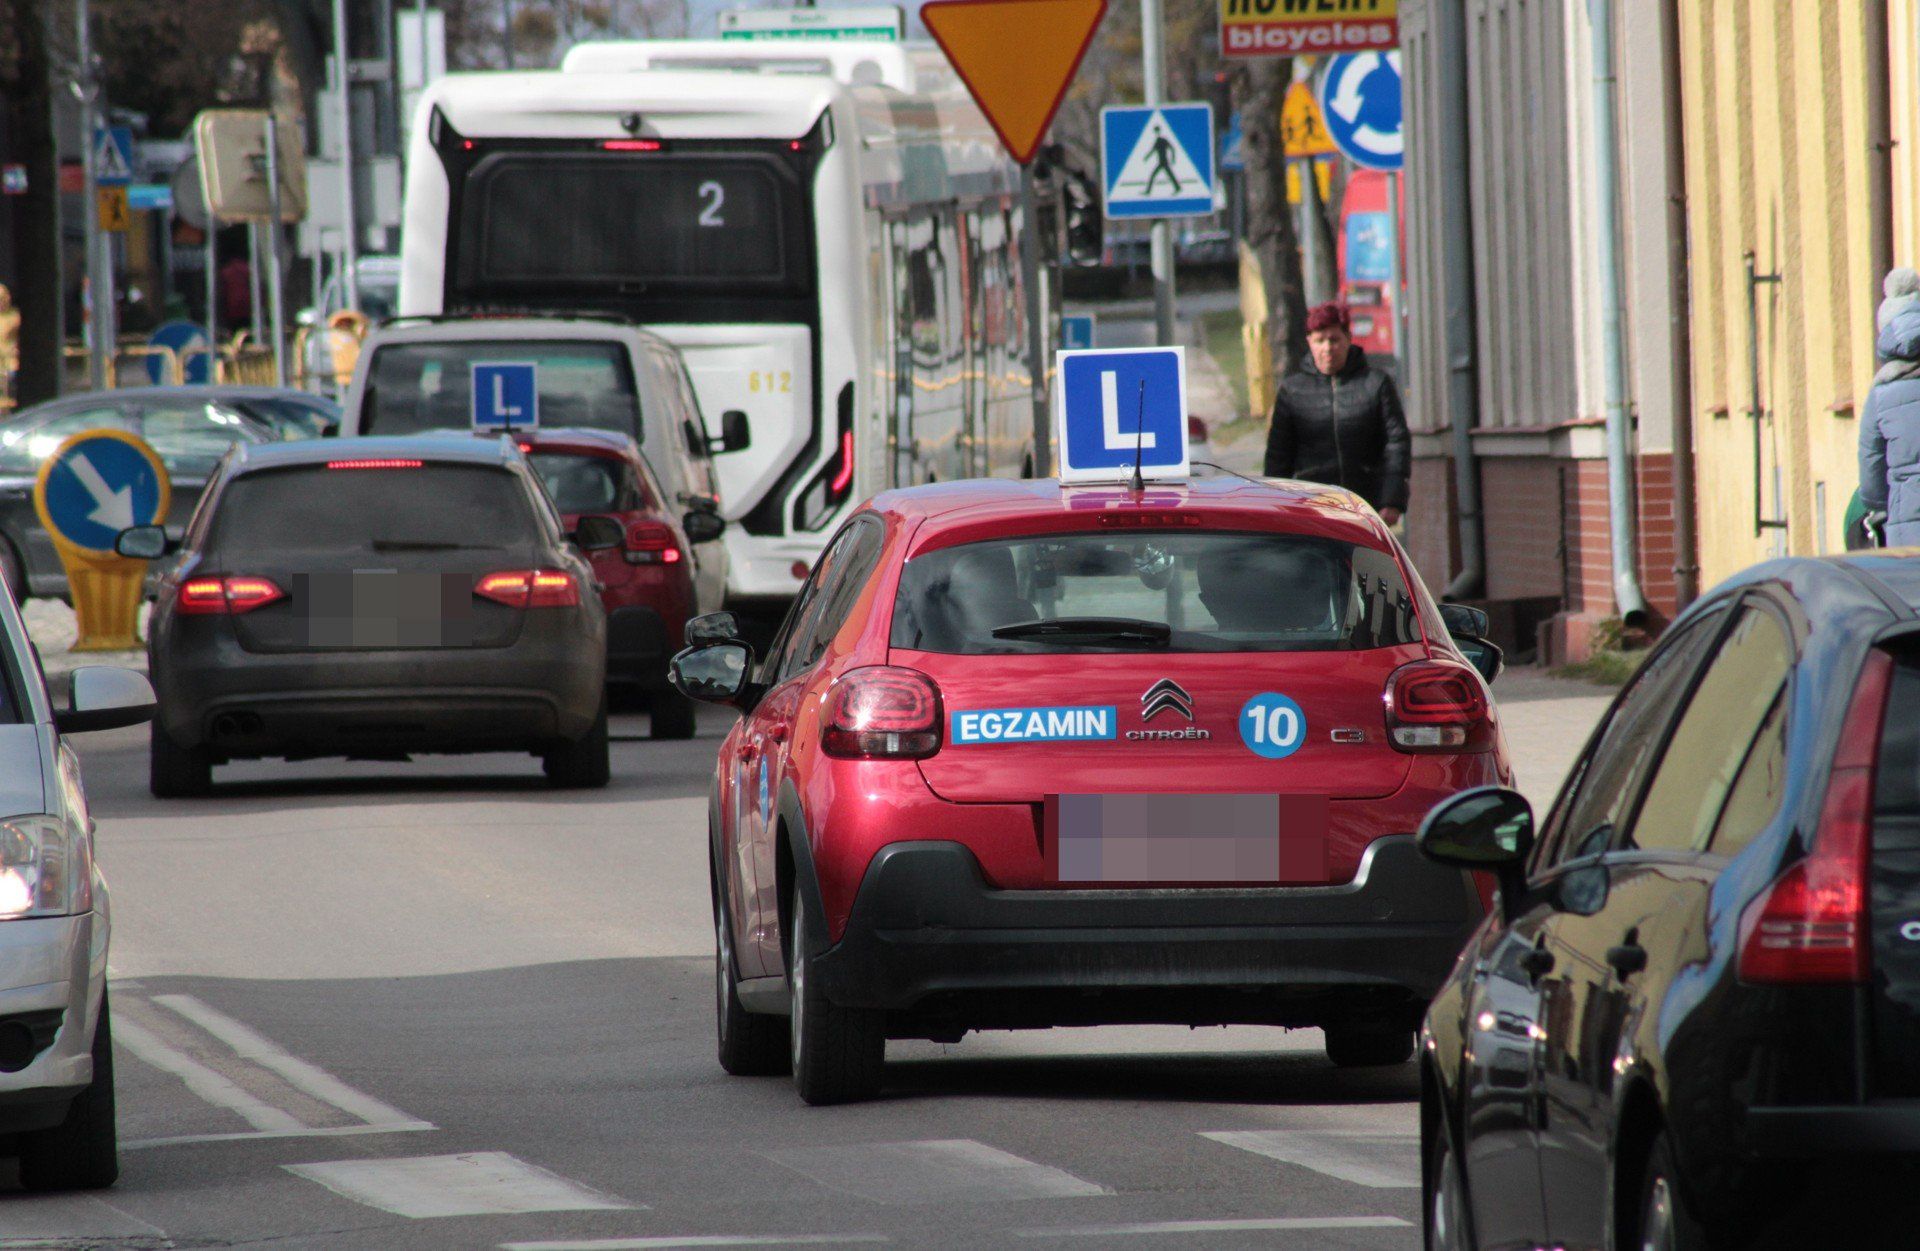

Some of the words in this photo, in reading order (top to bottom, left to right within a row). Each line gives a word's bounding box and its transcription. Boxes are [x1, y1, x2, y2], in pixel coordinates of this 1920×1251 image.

[1228, 23, 1391, 50] bicycles
[698, 180, 725, 227] 2
[494, 374, 521, 415] L
[749, 371, 792, 393] 612
[1101, 371, 1156, 449] L
[960, 709, 1108, 741] EGZAMIN
[1248, 704, 1300, 747] 10
[1330, 728, 1366, 743] C3
